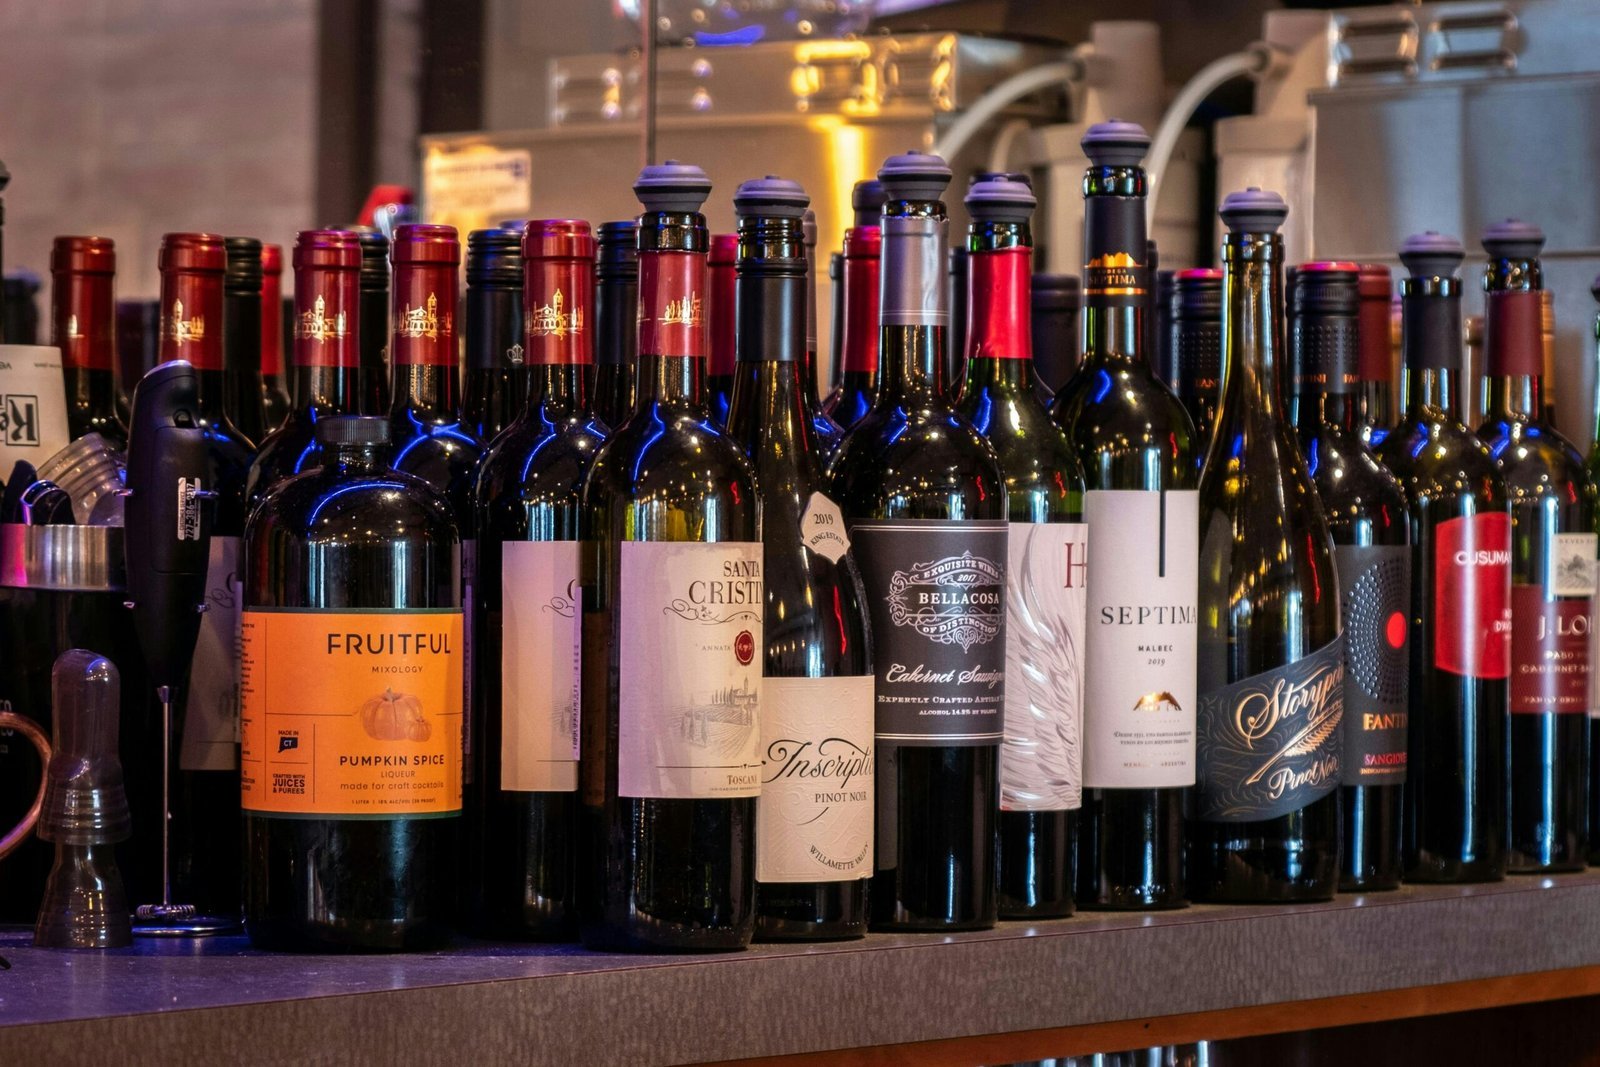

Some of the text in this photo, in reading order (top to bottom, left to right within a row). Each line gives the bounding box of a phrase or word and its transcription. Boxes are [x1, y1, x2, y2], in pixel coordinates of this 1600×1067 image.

[813, 513, 834, 525] 2019
[810, 533, 826, 546] KING
[723, 560, 761, 577] SANTA
[923, 559, 999, 579] EXQUISITE WINES
[957, 574, 977, 582] 2017
[919, 593, 999, 605] BELLACOSA
[1100, 606, 1197, 625] SEPTIMA
[922, 617, 997, 633] OF DISTINCTION
[327, 633, 451, 655] FRUITFUL
[1148, 658, 1166, 666] 2019
[372, 666, 423, 674] MIXOLOGY
[886, 663, 956, 683] Cabernet
[878, 695, 930, 704] EXPERTLY
[932, 696, 973, 704] CRAFTED
[339, 754, 445, 766] PUMPKIN SPICE
[381, 770, 416, 779] LIQUEUR
[1268, 759, 1320, 800] Pinot
[272, 778, 305, 788] JUICES
[340, 781, 444, 790] made for craft cocktails
[278, 787, 305, 795] PUREES
[815, 791, 867, 803] PINOT NOIR
[809, 844, 855, 871] WILLAMETTE
